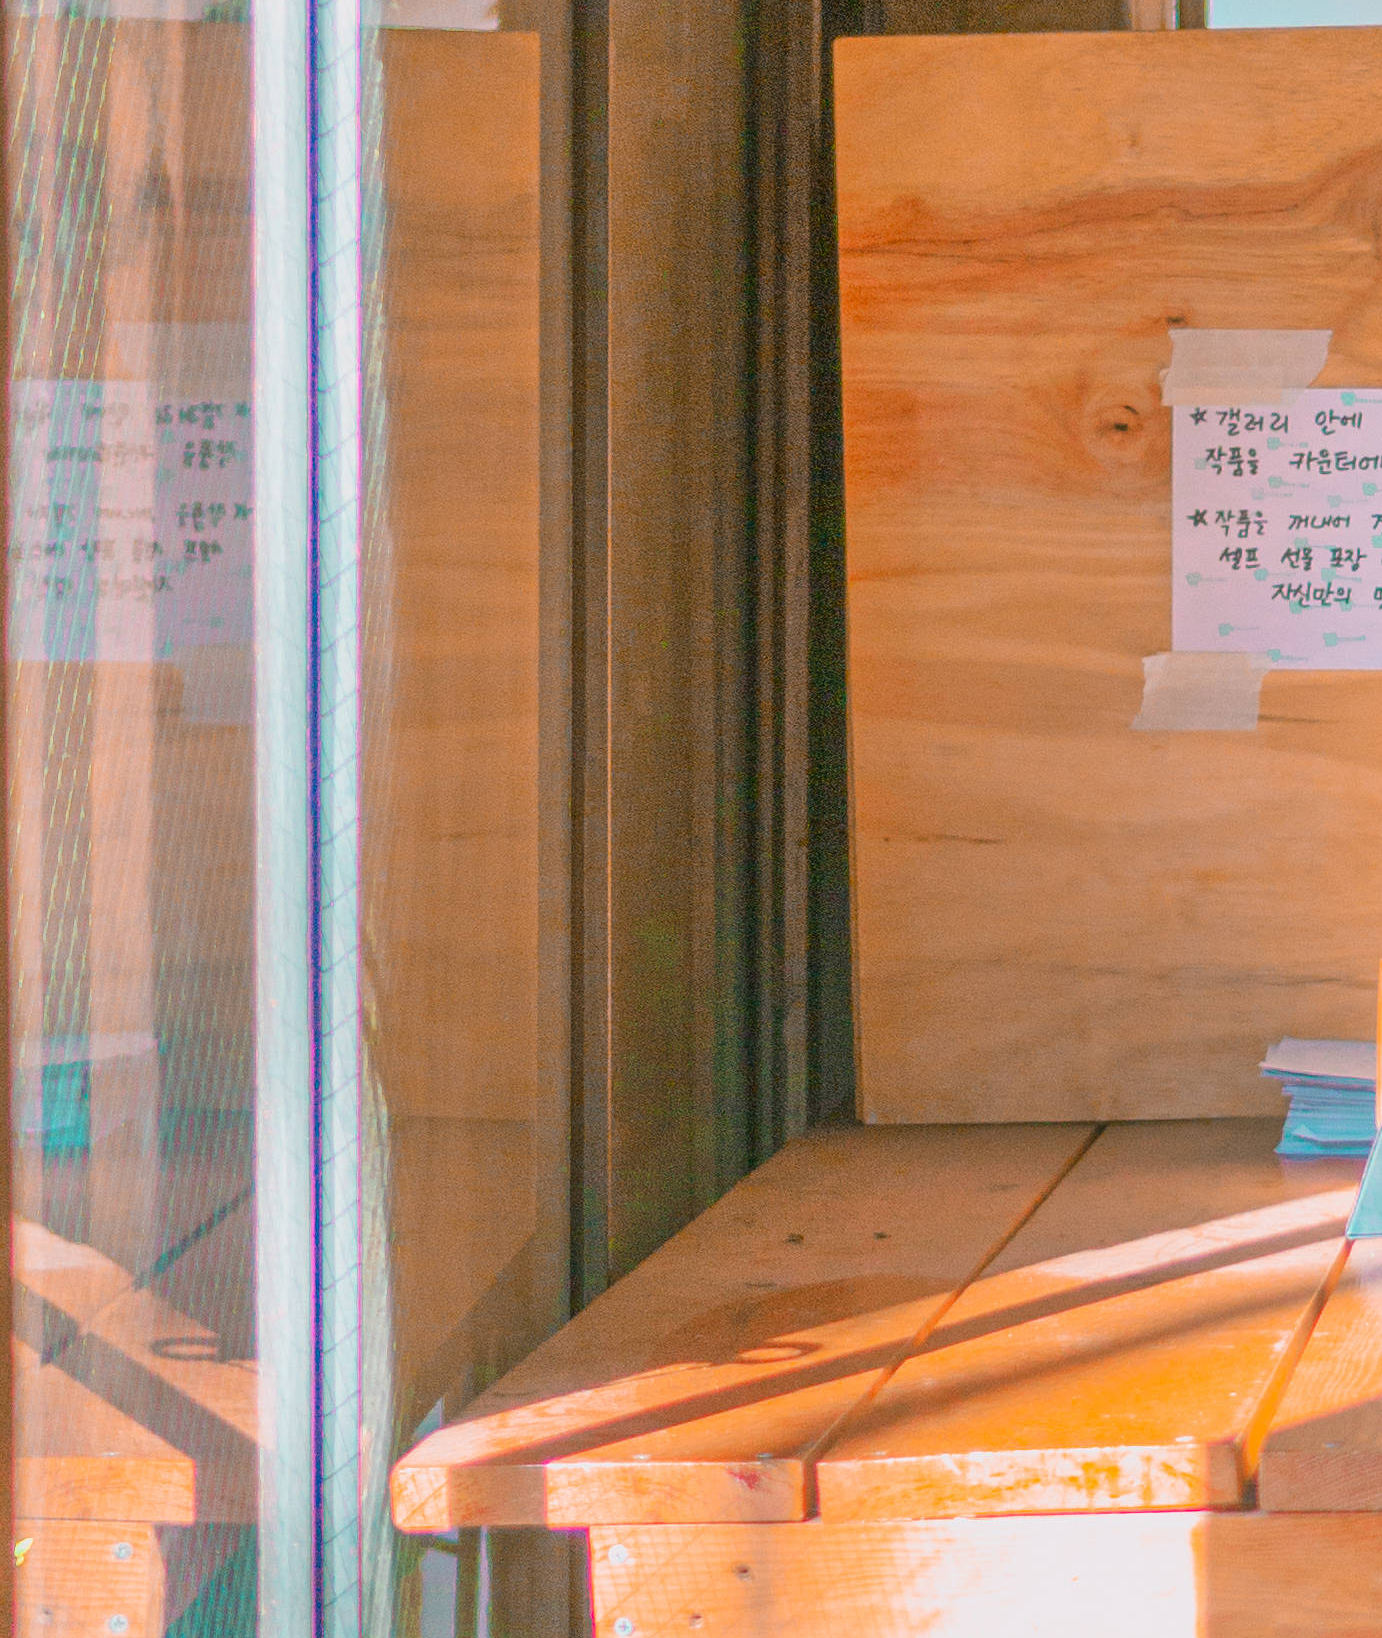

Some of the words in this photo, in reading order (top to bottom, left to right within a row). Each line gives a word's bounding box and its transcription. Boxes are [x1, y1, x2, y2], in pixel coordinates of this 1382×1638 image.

[1216, 407, 1289, 437] 갤러리
[1315, 409, 1363, 436] 안에
[1205, 446, 1260, 476] 작품을
[1214, 509, 1268, 539] 작품을
[1219, 546, 1261, 570] 셀프
[1280, 546, 1314, 571] 선물
[1329, 546, 1367, 572] 포장
[1271, 581, 1352, 608] 자신만의
